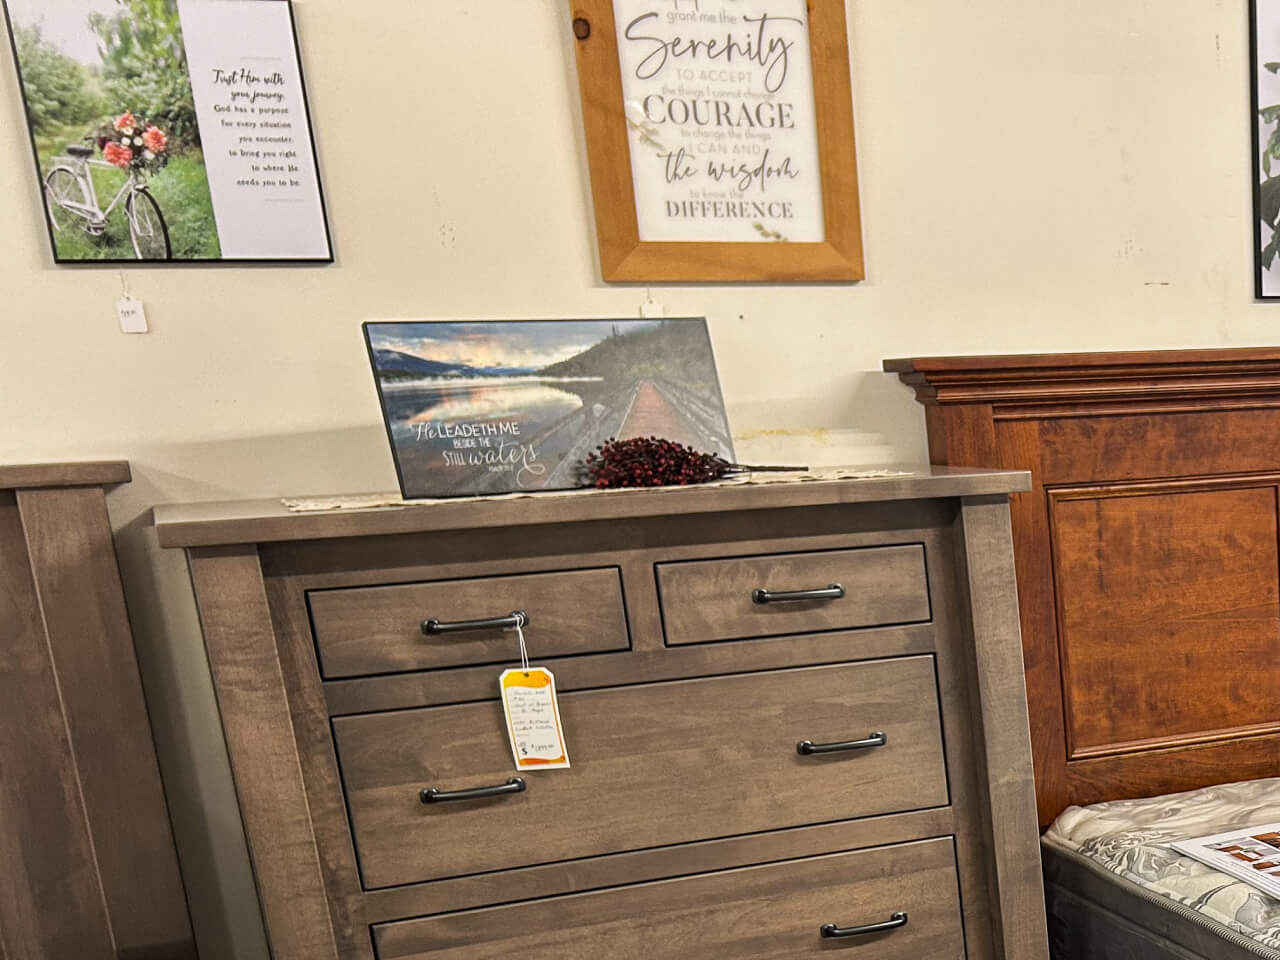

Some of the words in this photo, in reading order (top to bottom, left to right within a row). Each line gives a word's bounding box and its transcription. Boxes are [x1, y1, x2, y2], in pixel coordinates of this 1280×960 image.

[666, 11, 697, 24] grant
[699, 15, 717, 24] me
[719, 11, 737, 24] the
[625, 12, 803, 94] Serenity
[211, 69, 238, 85] Trust
[240, 68, 261, 86] Him
[263, 72, 285, 85] with
[676, 69, 694, 82] TO
[699, 69, 753, 83] ACCEPT
[213, 105, 231, 113] God
[235, 105, 248, 113] has
[259, 107, 289, 115] purpose
[642, 95, 796, 129] COURAGE
[221, 119, 233, 128] for
[236, 121, 257, 129] every
[260, 120, 292, 128] situation
[240, 149, 260, 158] bring
[279, 151, 297, 159] right
[697, 143, 728, 154] CAN
[732, 144, 761, 154] AND
[656, 147, 699, 184] the
[708, 148, 801, 192] wisdom
[262, 180, 276, 188] you
[665, 200, 794, 219] DIFFERENCE
[437, 423, 498, 438] LEADETH
[499, 421, 521, 435] ME
[453, 439, 476, 449] BESIDE
[478, 438, 491, 448] THE
[442, 450, 467, 467] STILL
[469, 441, 546, 488] waters
